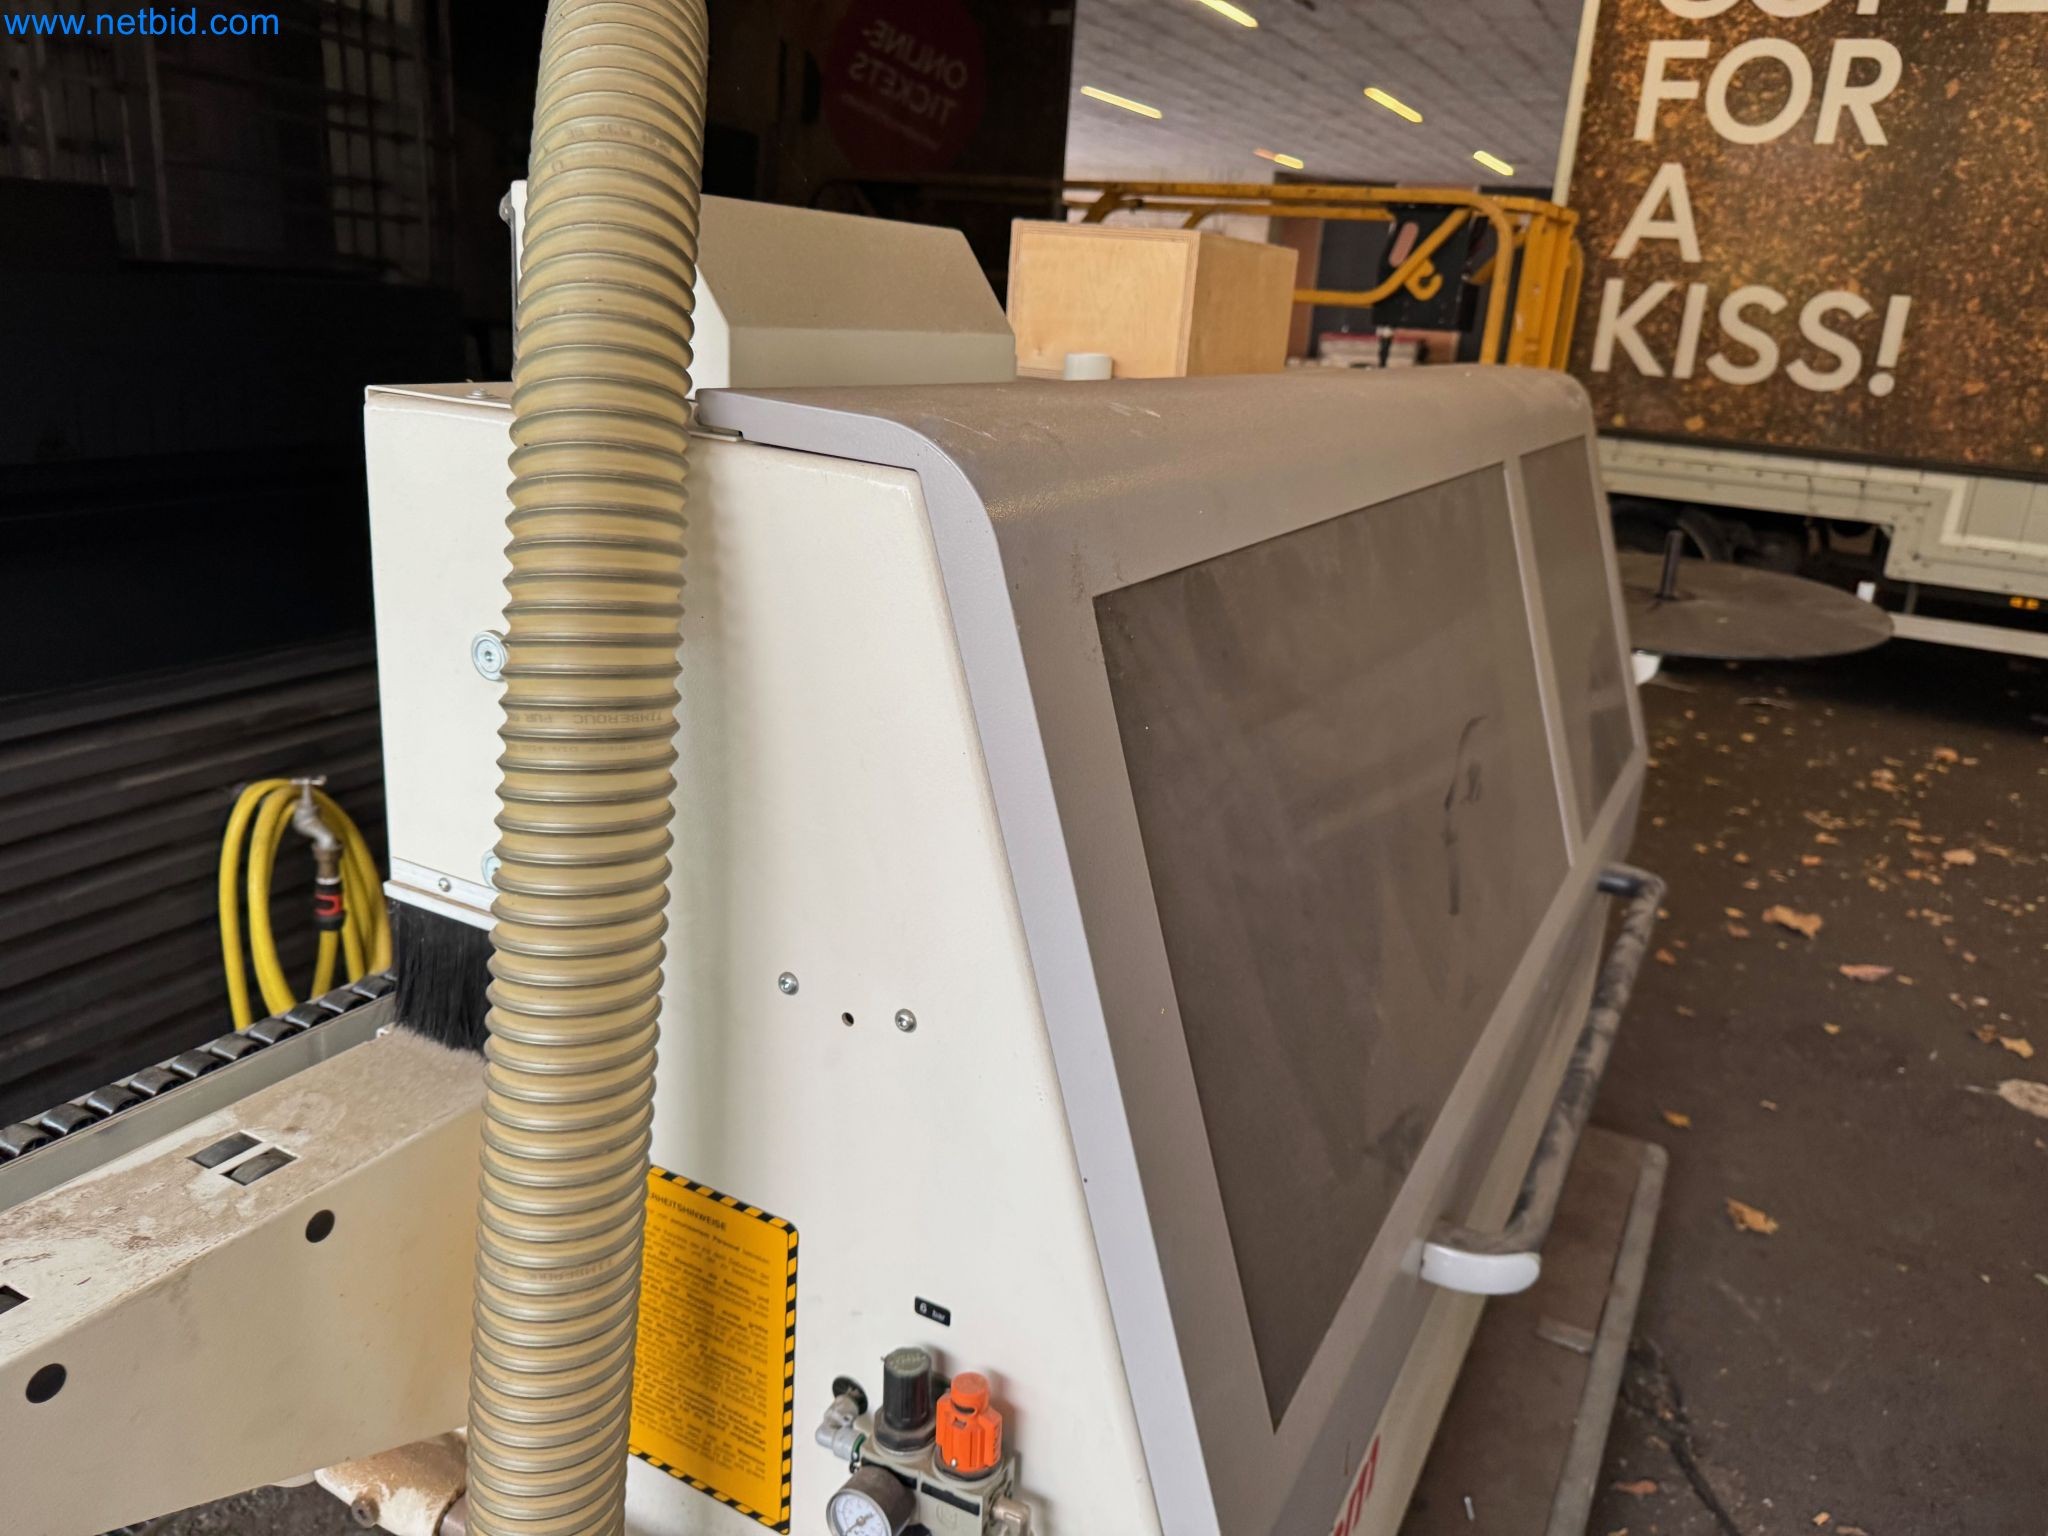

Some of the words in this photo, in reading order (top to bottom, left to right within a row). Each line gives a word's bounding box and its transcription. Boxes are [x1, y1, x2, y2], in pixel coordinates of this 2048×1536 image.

[1633, 37, 1903, 146] FOR
[1610, 162, 1701, 263] A
[1590, 277, 1913, 398] KISS!
